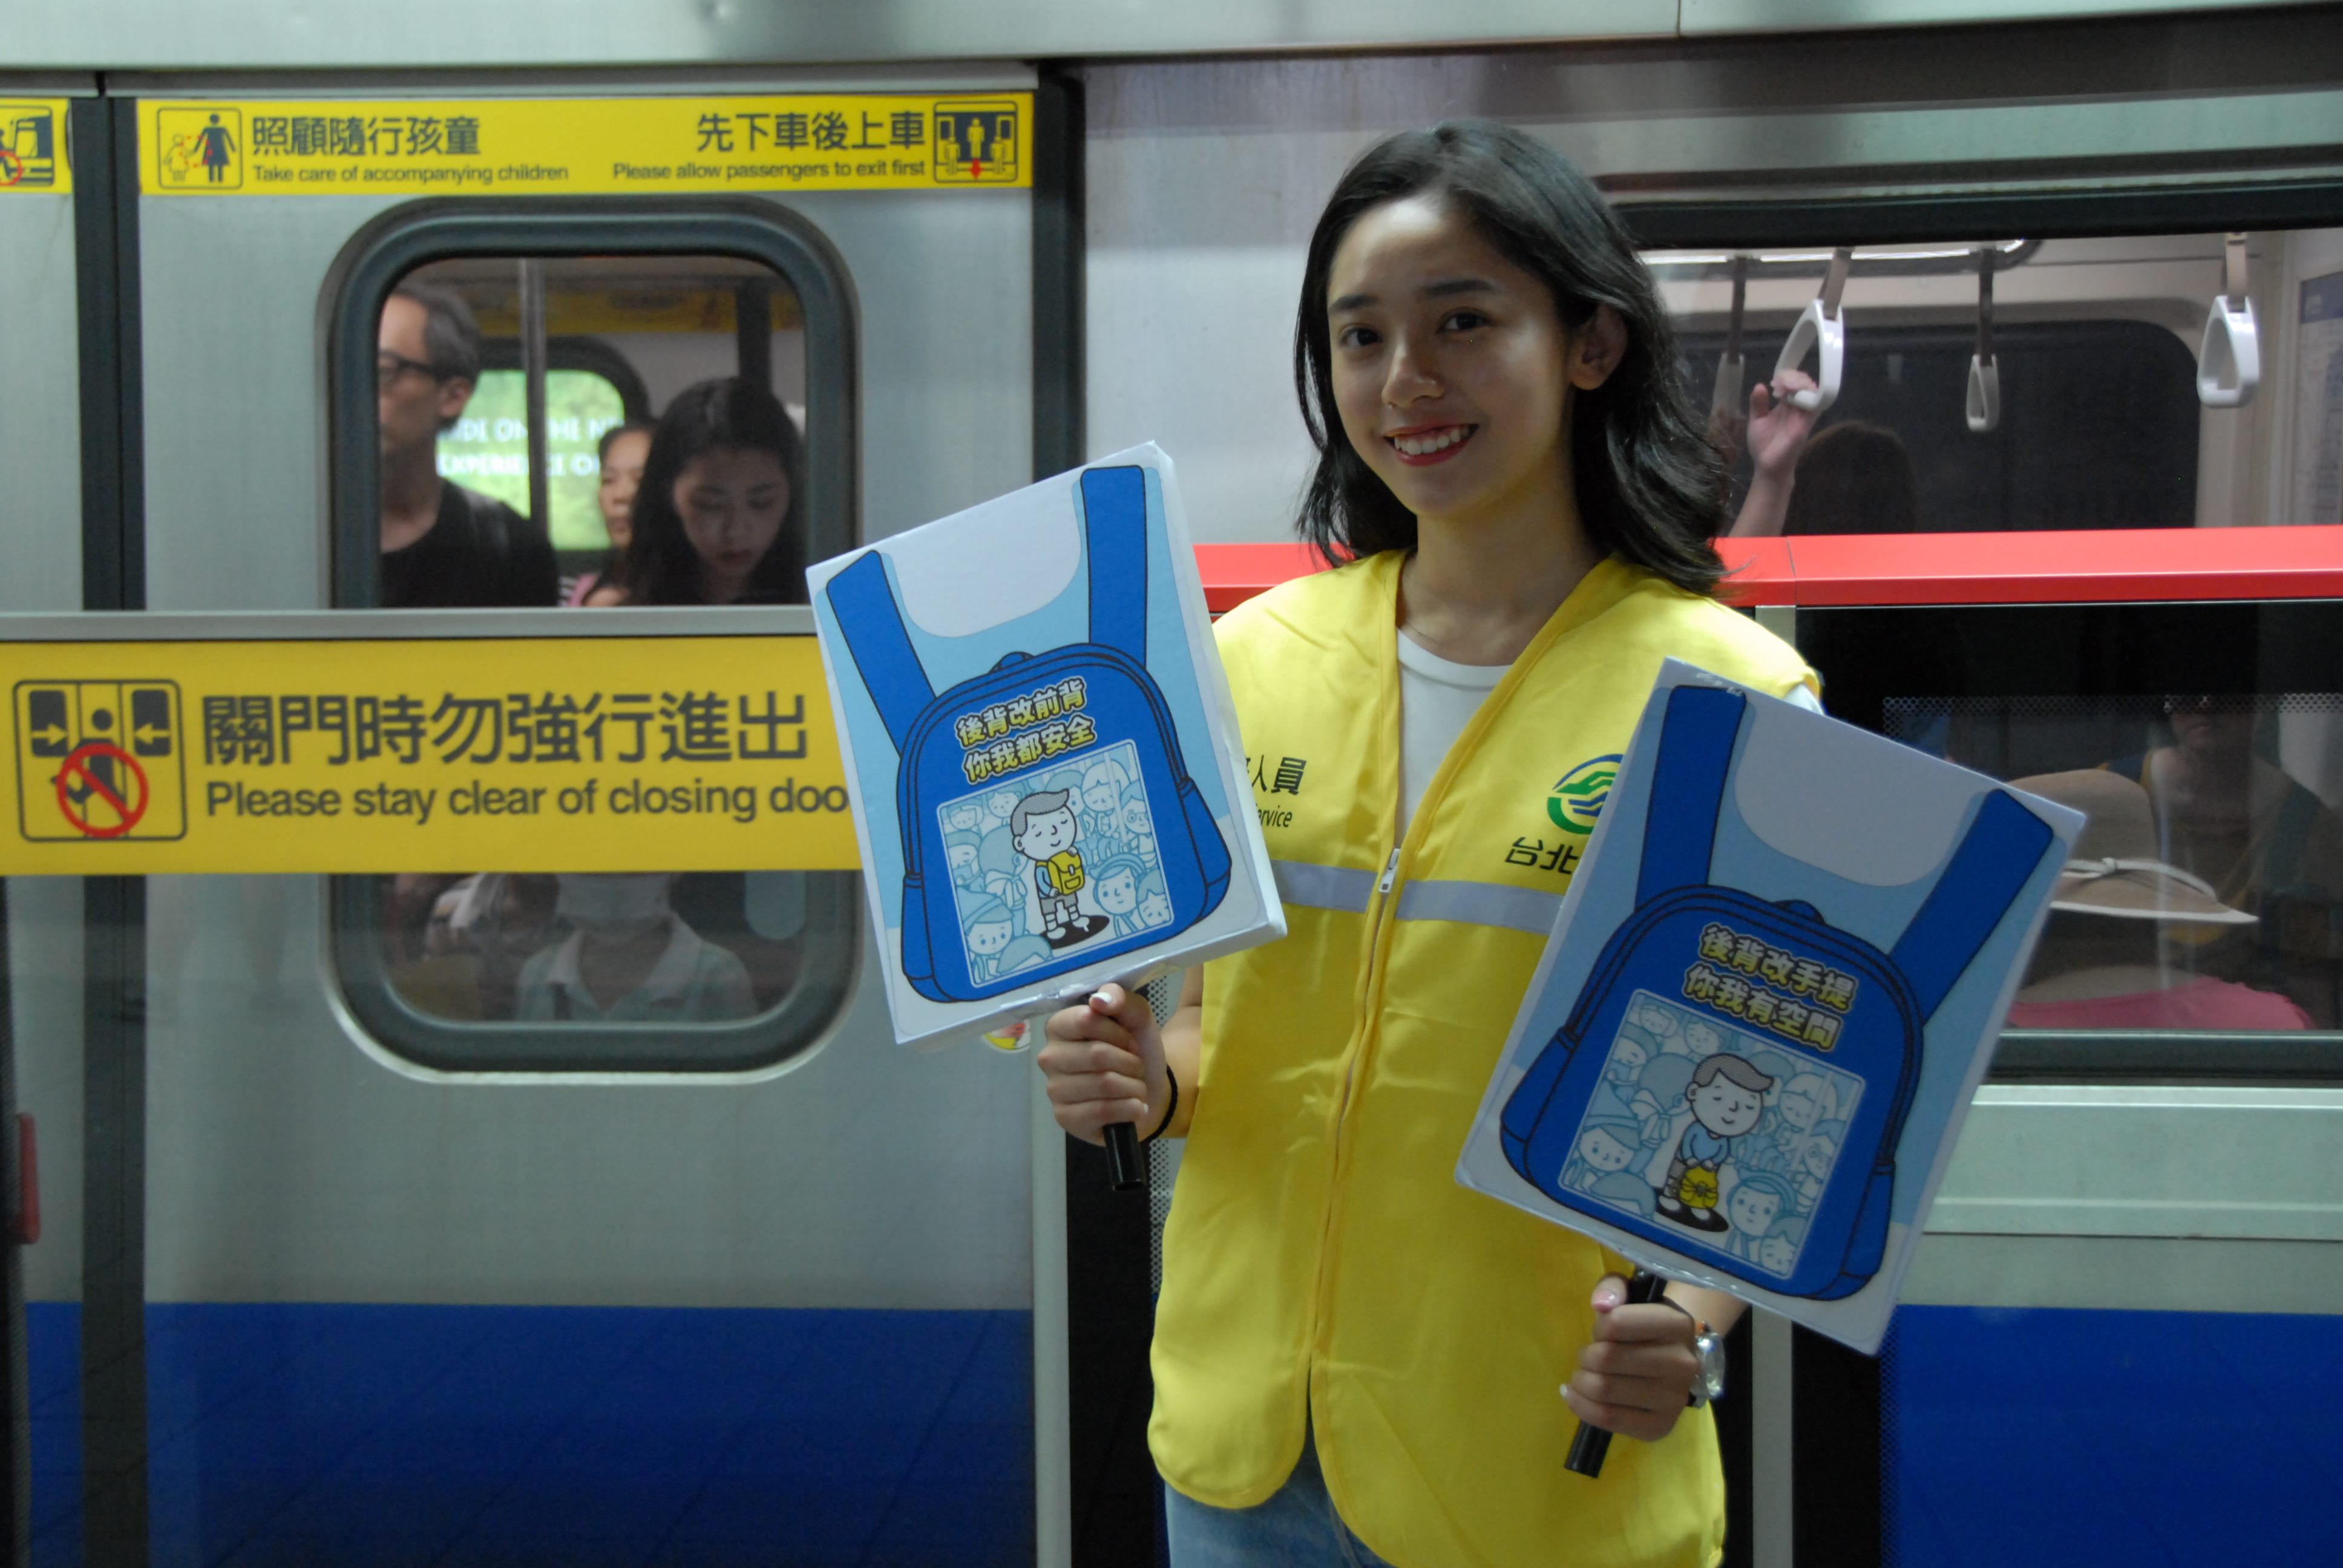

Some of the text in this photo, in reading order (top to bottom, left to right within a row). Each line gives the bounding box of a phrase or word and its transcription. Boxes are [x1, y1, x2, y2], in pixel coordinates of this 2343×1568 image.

[252, 117, 481, 156] 照顧隨行孩童
[696, 111, 926, 152] 先下車後上車
[252, 164, 569, 186] Take care of accompanying children
[613, 158, 926, 181] Please allow passengers to exit first
[202, 691, 807, 766] 關門時勿強行進出
[955, 676, 1086, 749] 後背改前背
[963, 714, 1096, 783] 你我都安全
[206, 780, 342, 817] Please
[353, 782, 437, 826] stay
[448, 779, 546, 815] clear
[558, 778, 599, 814] of
[608, 777, 758, 823] closing
[1504, 836, 1579, 875] 台北
[1699, 923, 1858, 1013] 後背改手提
[1683, 961, 1843, 1051] 你我有空間
